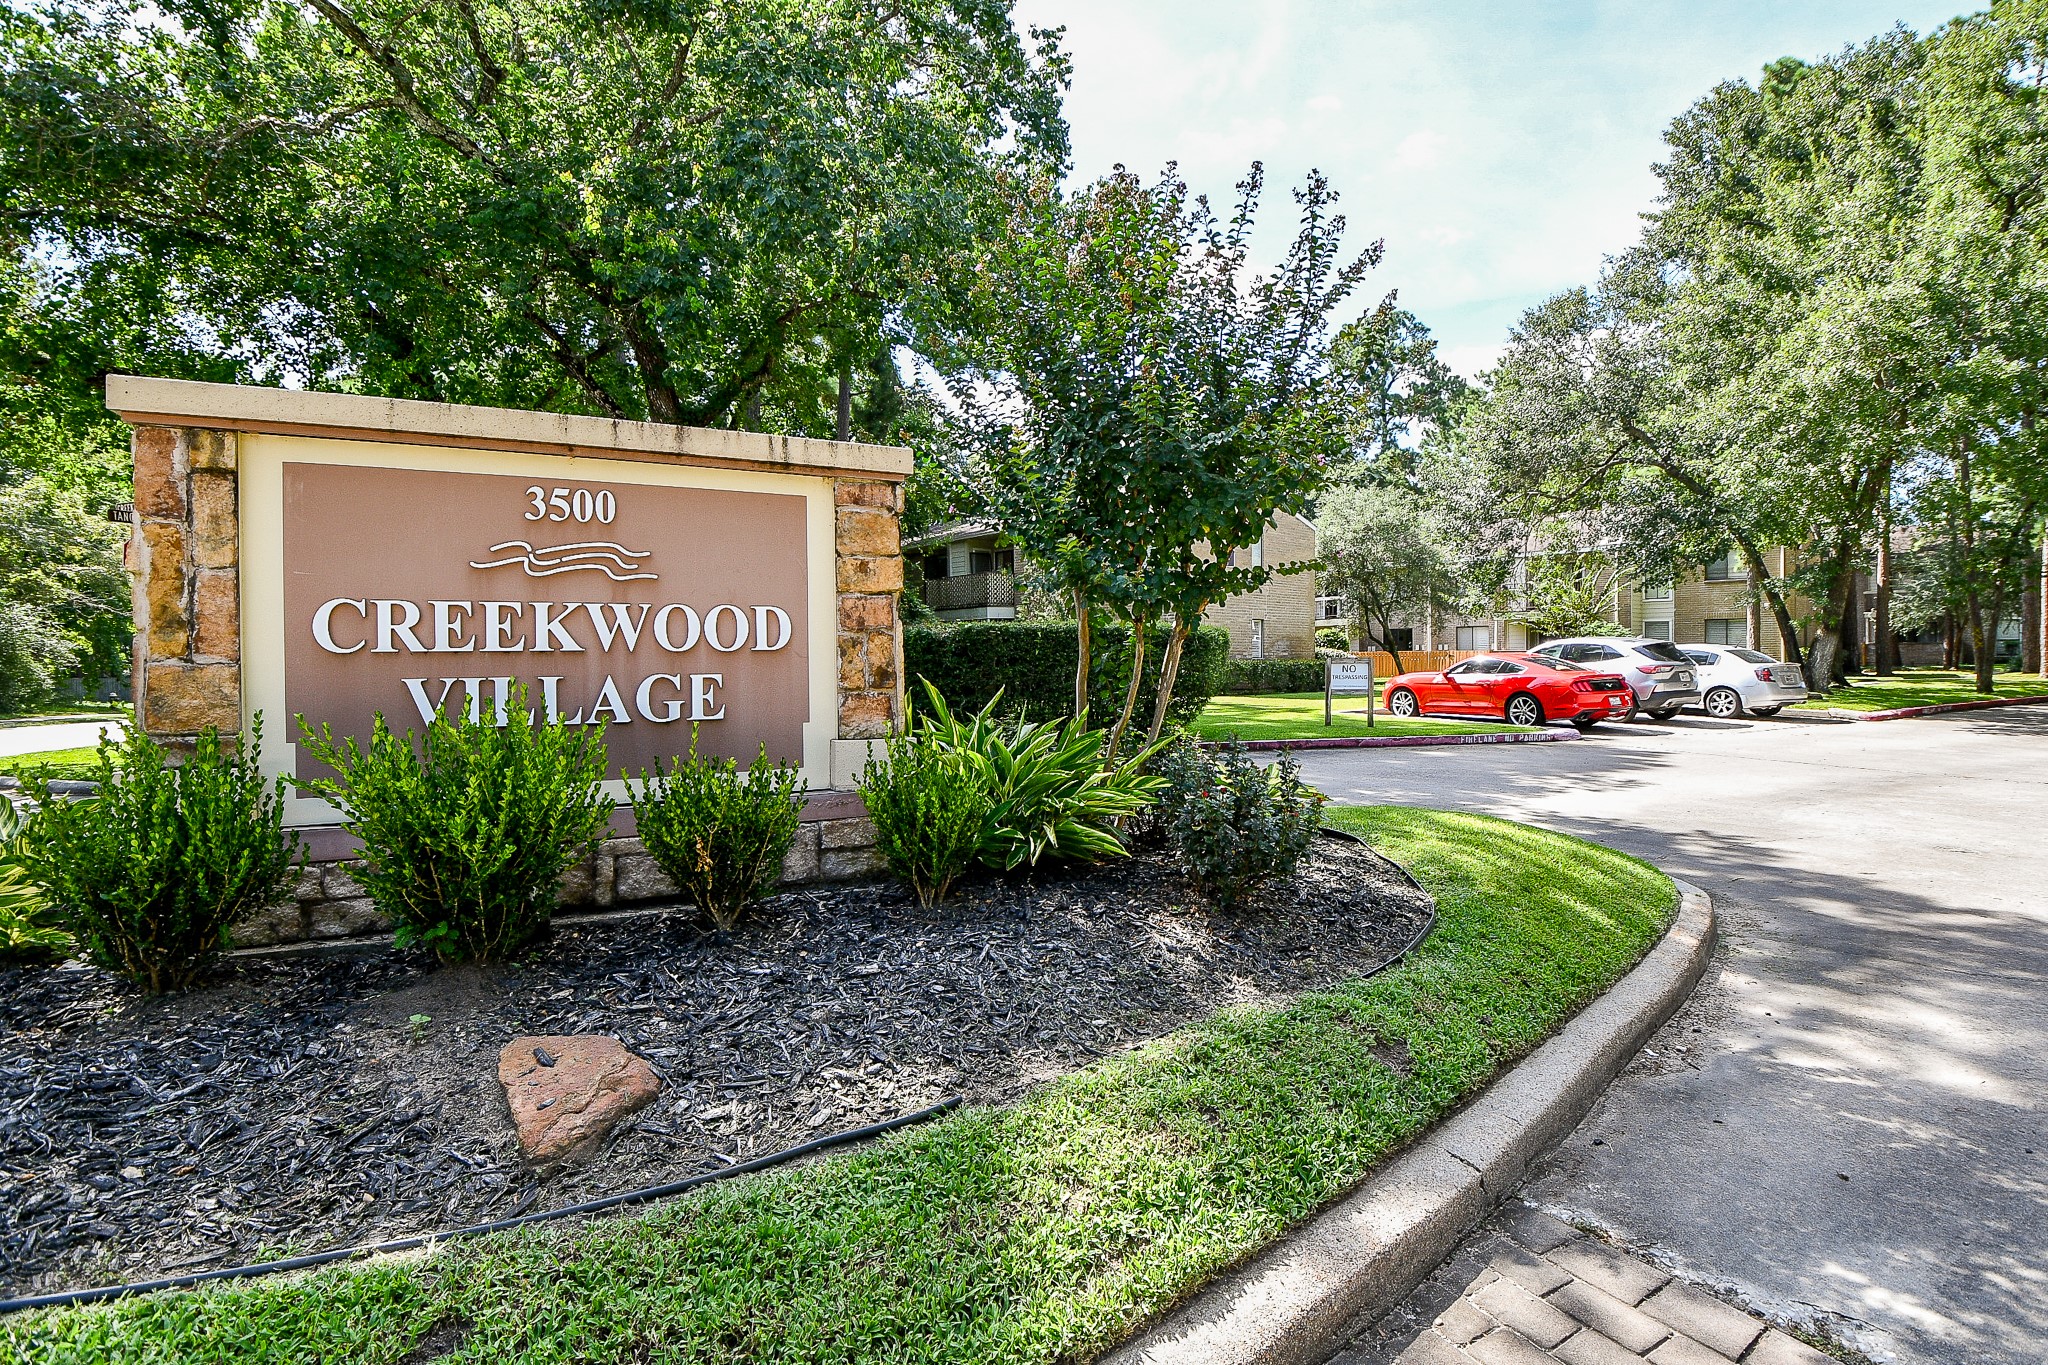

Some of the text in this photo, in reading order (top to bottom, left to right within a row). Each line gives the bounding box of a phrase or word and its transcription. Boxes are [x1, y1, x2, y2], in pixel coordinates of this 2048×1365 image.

[523, 485, 617, 524] 3500
[311, 597, 792, 655] CREEKWOOD
[1341, 664, 1357, 672] NO
[400, 672, 726, 728] VILLAGE
[1504, 734, 1515, 742] NO
[1519, 733, 1551, 742] PARKING
